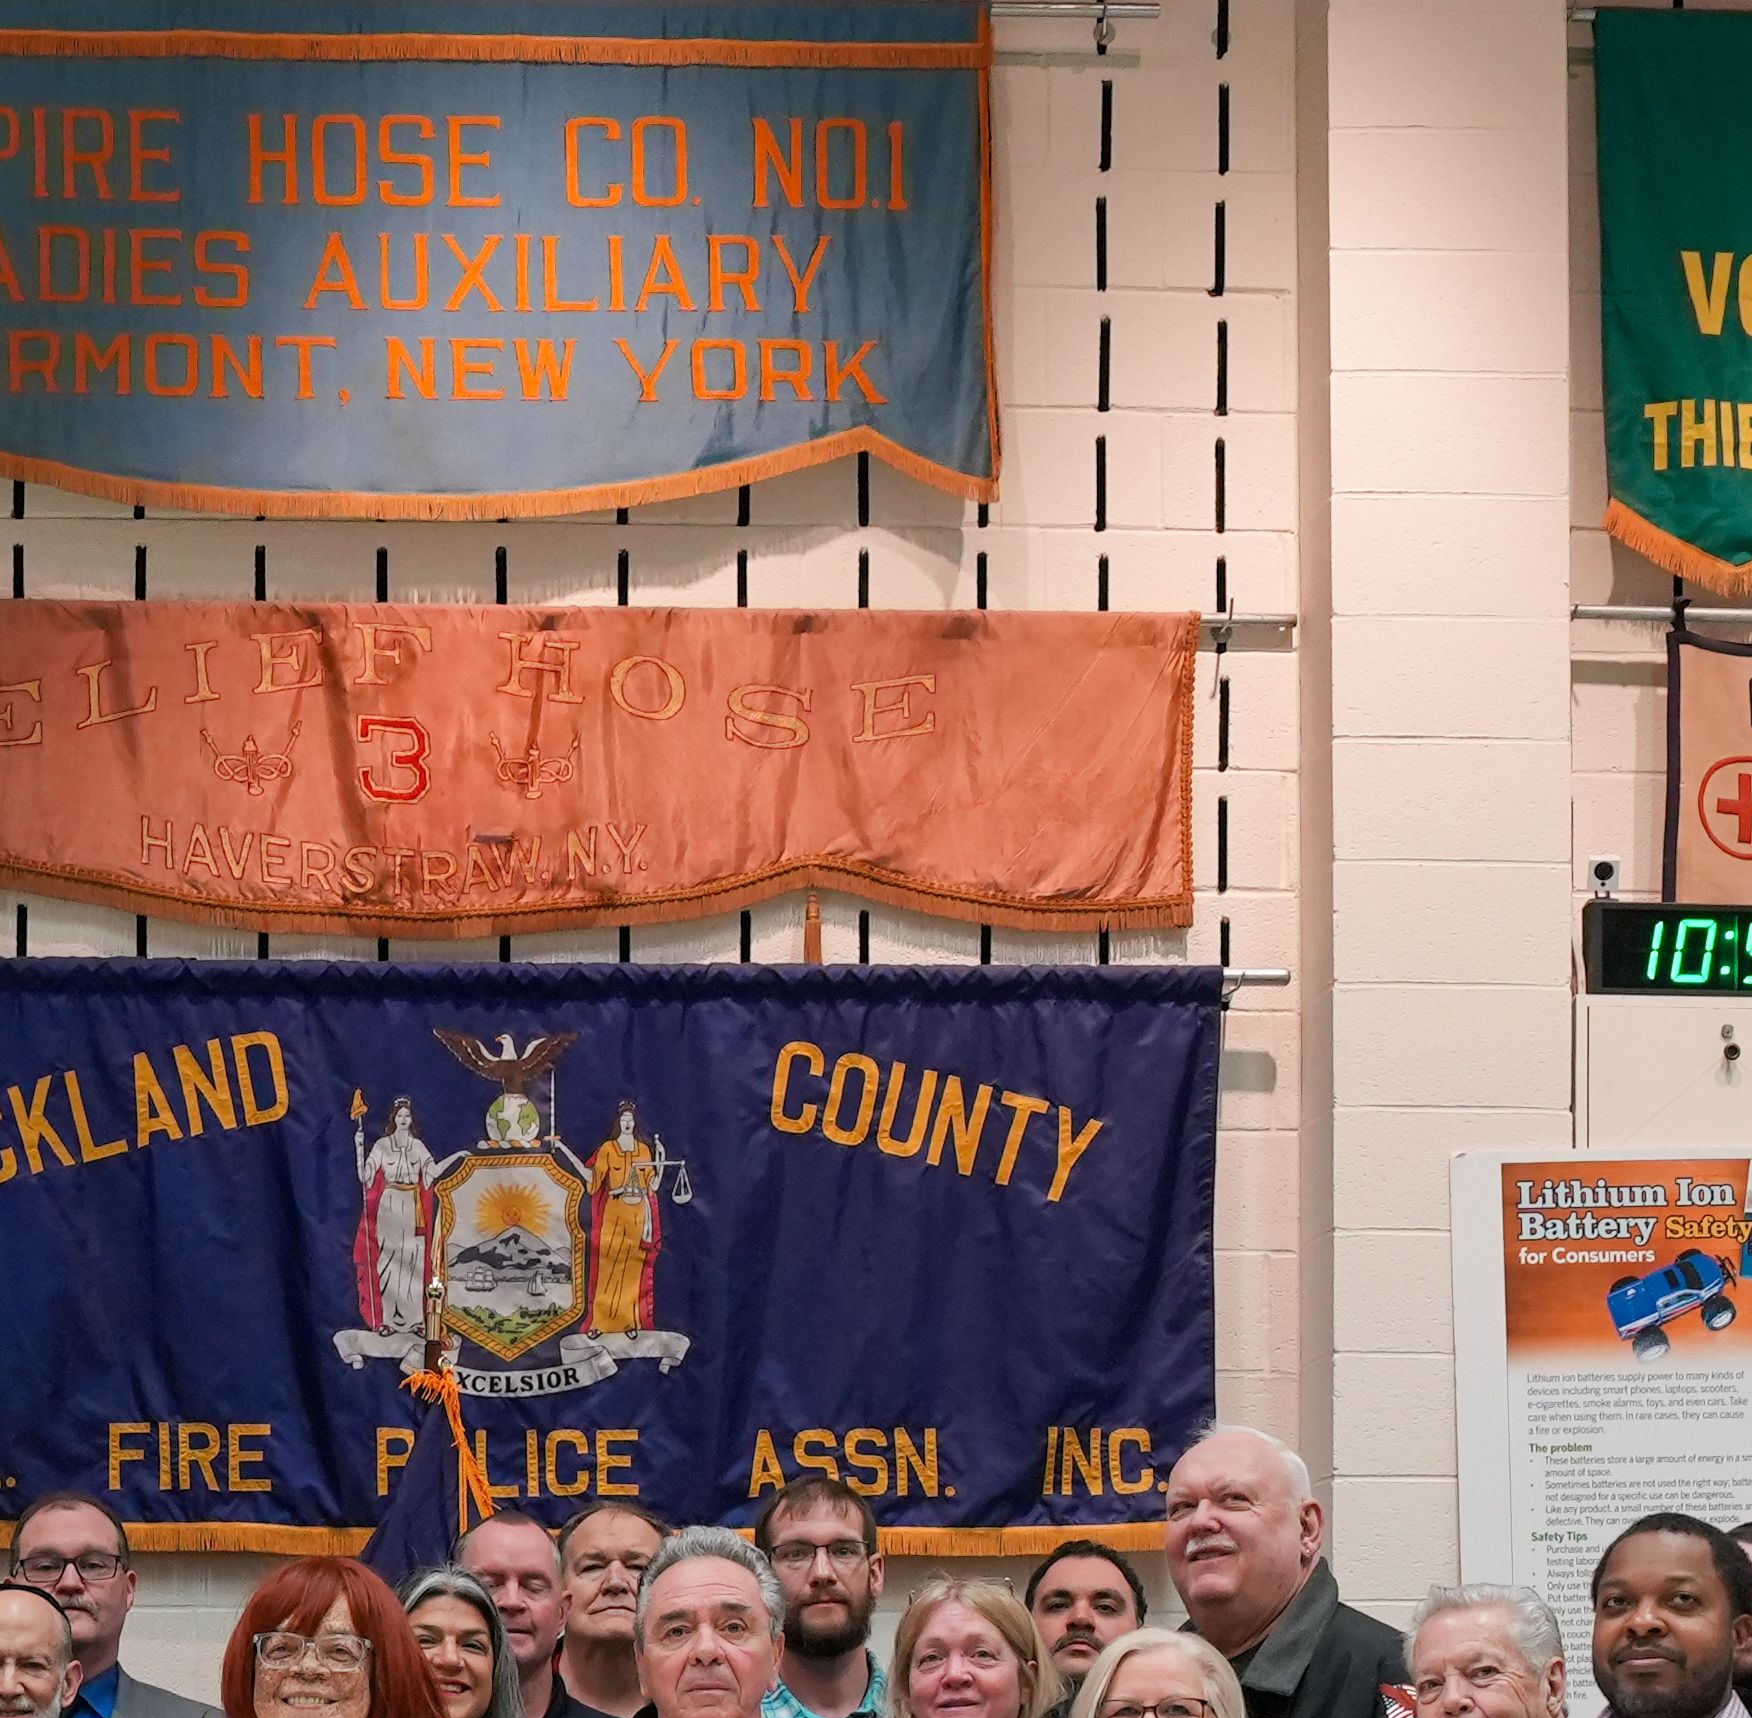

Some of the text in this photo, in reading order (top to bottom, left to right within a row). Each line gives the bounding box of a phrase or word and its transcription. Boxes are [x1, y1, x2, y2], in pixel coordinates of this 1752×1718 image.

[247, 112, 503, 208] HOSE
[562, 115, 700, 209] CO.
[303, 233, 833, 315] AUXILIARY
[385, 337, 576, 402] NEW
[615, 338, 887, 406] YORK
[501, 630, 938, 749] HOSE
[356, 714, 431, 806] 3
[769, 1041, 1104, 1203] COUNTY
[1516, 1177, 1736, 1209] Lithium Ion
[1518, 1212, 1658, 1246] Battery
[1518, 1247, 1655, 1265] for Consumers
[456, 1367, 580, 1394] XCELSIOR
[108, 1420, 272, 1494] FIRE
[376, 1427, 640, 1502] PLICE
[748, 1427, 955, 1502] ASSN.
[1043, 1427, 1169, 1497] INC.
